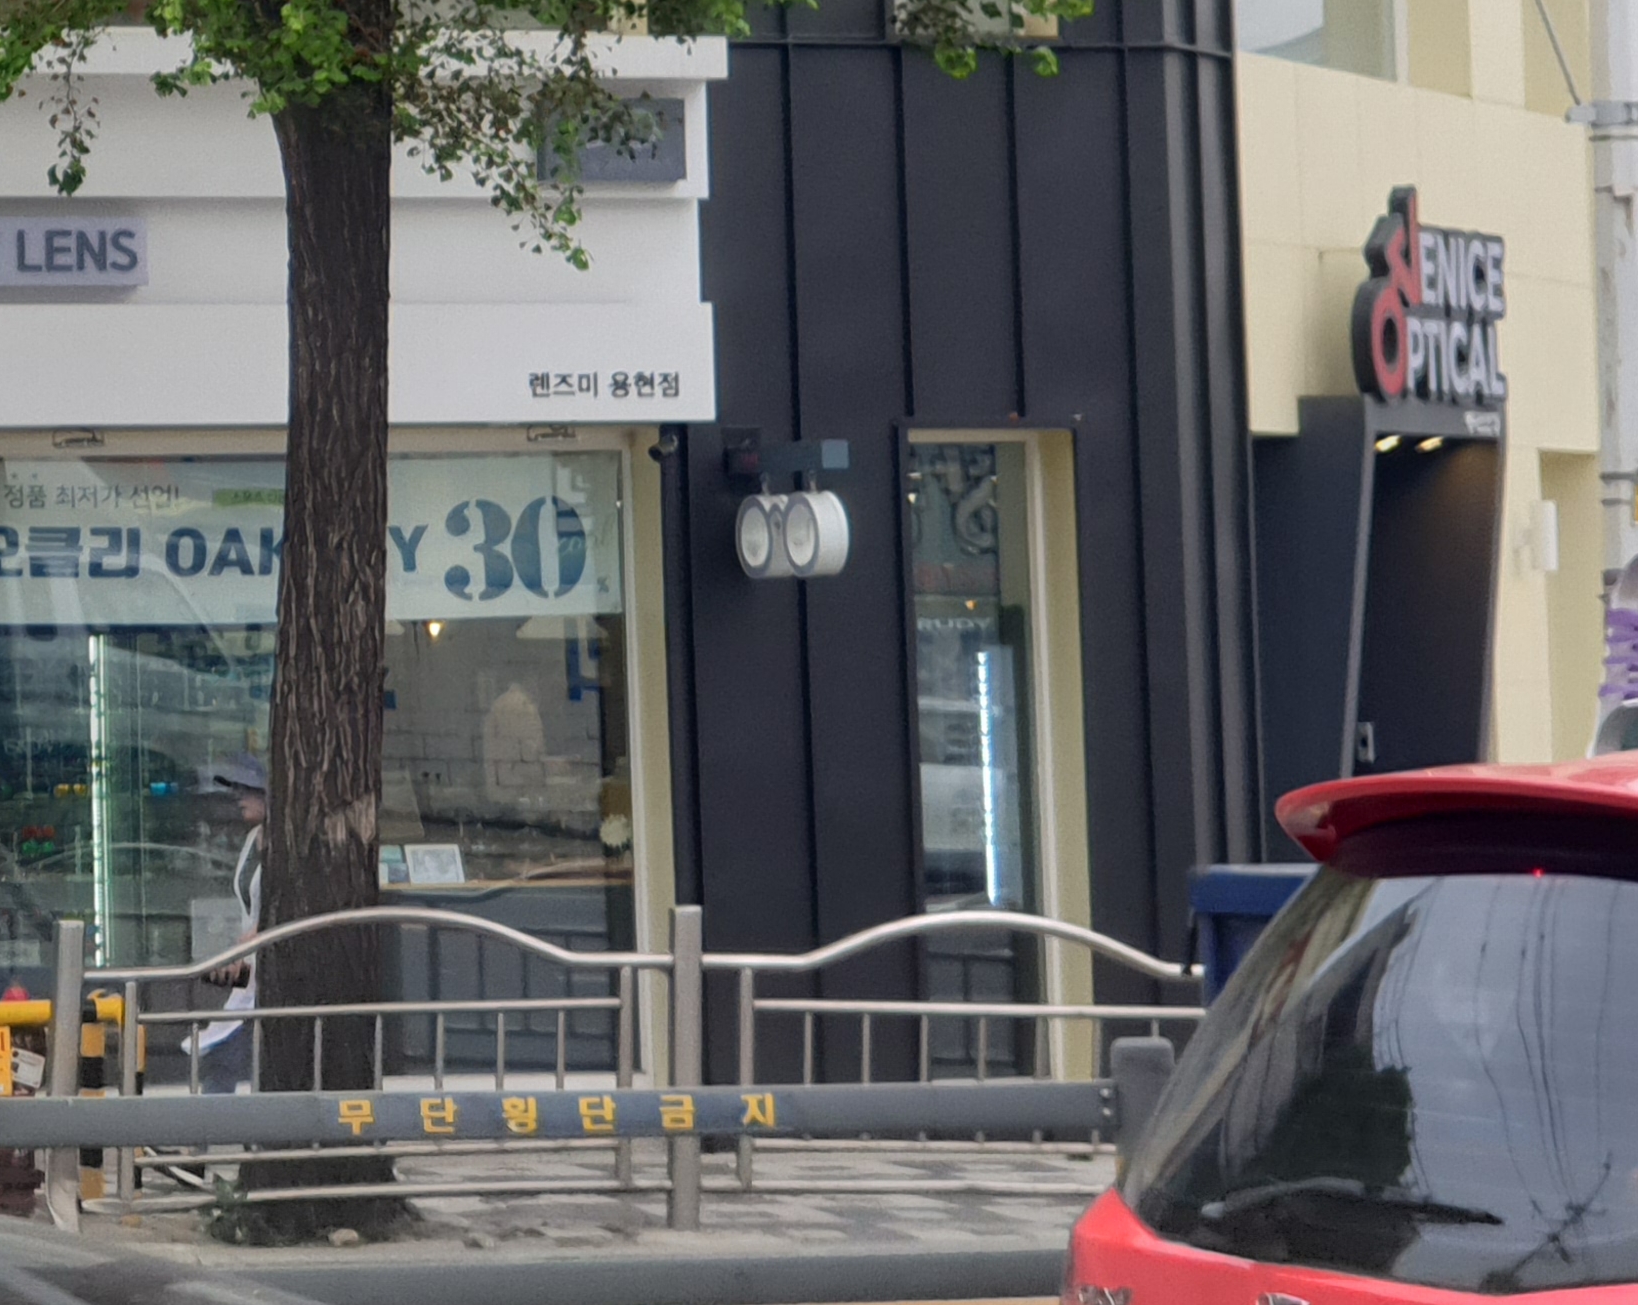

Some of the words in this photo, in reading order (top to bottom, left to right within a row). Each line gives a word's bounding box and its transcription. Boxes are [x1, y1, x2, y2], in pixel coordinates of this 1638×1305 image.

[15, 227, 139, 273] LENS
[528, 370, 599, 399] 렌즈미
[607, 370, 681, 399] 용현점
[3, 483, 48, 509] 정품
[55, 484, 123, 510] 최저가
[165, 524, 429, 578] OAKY
